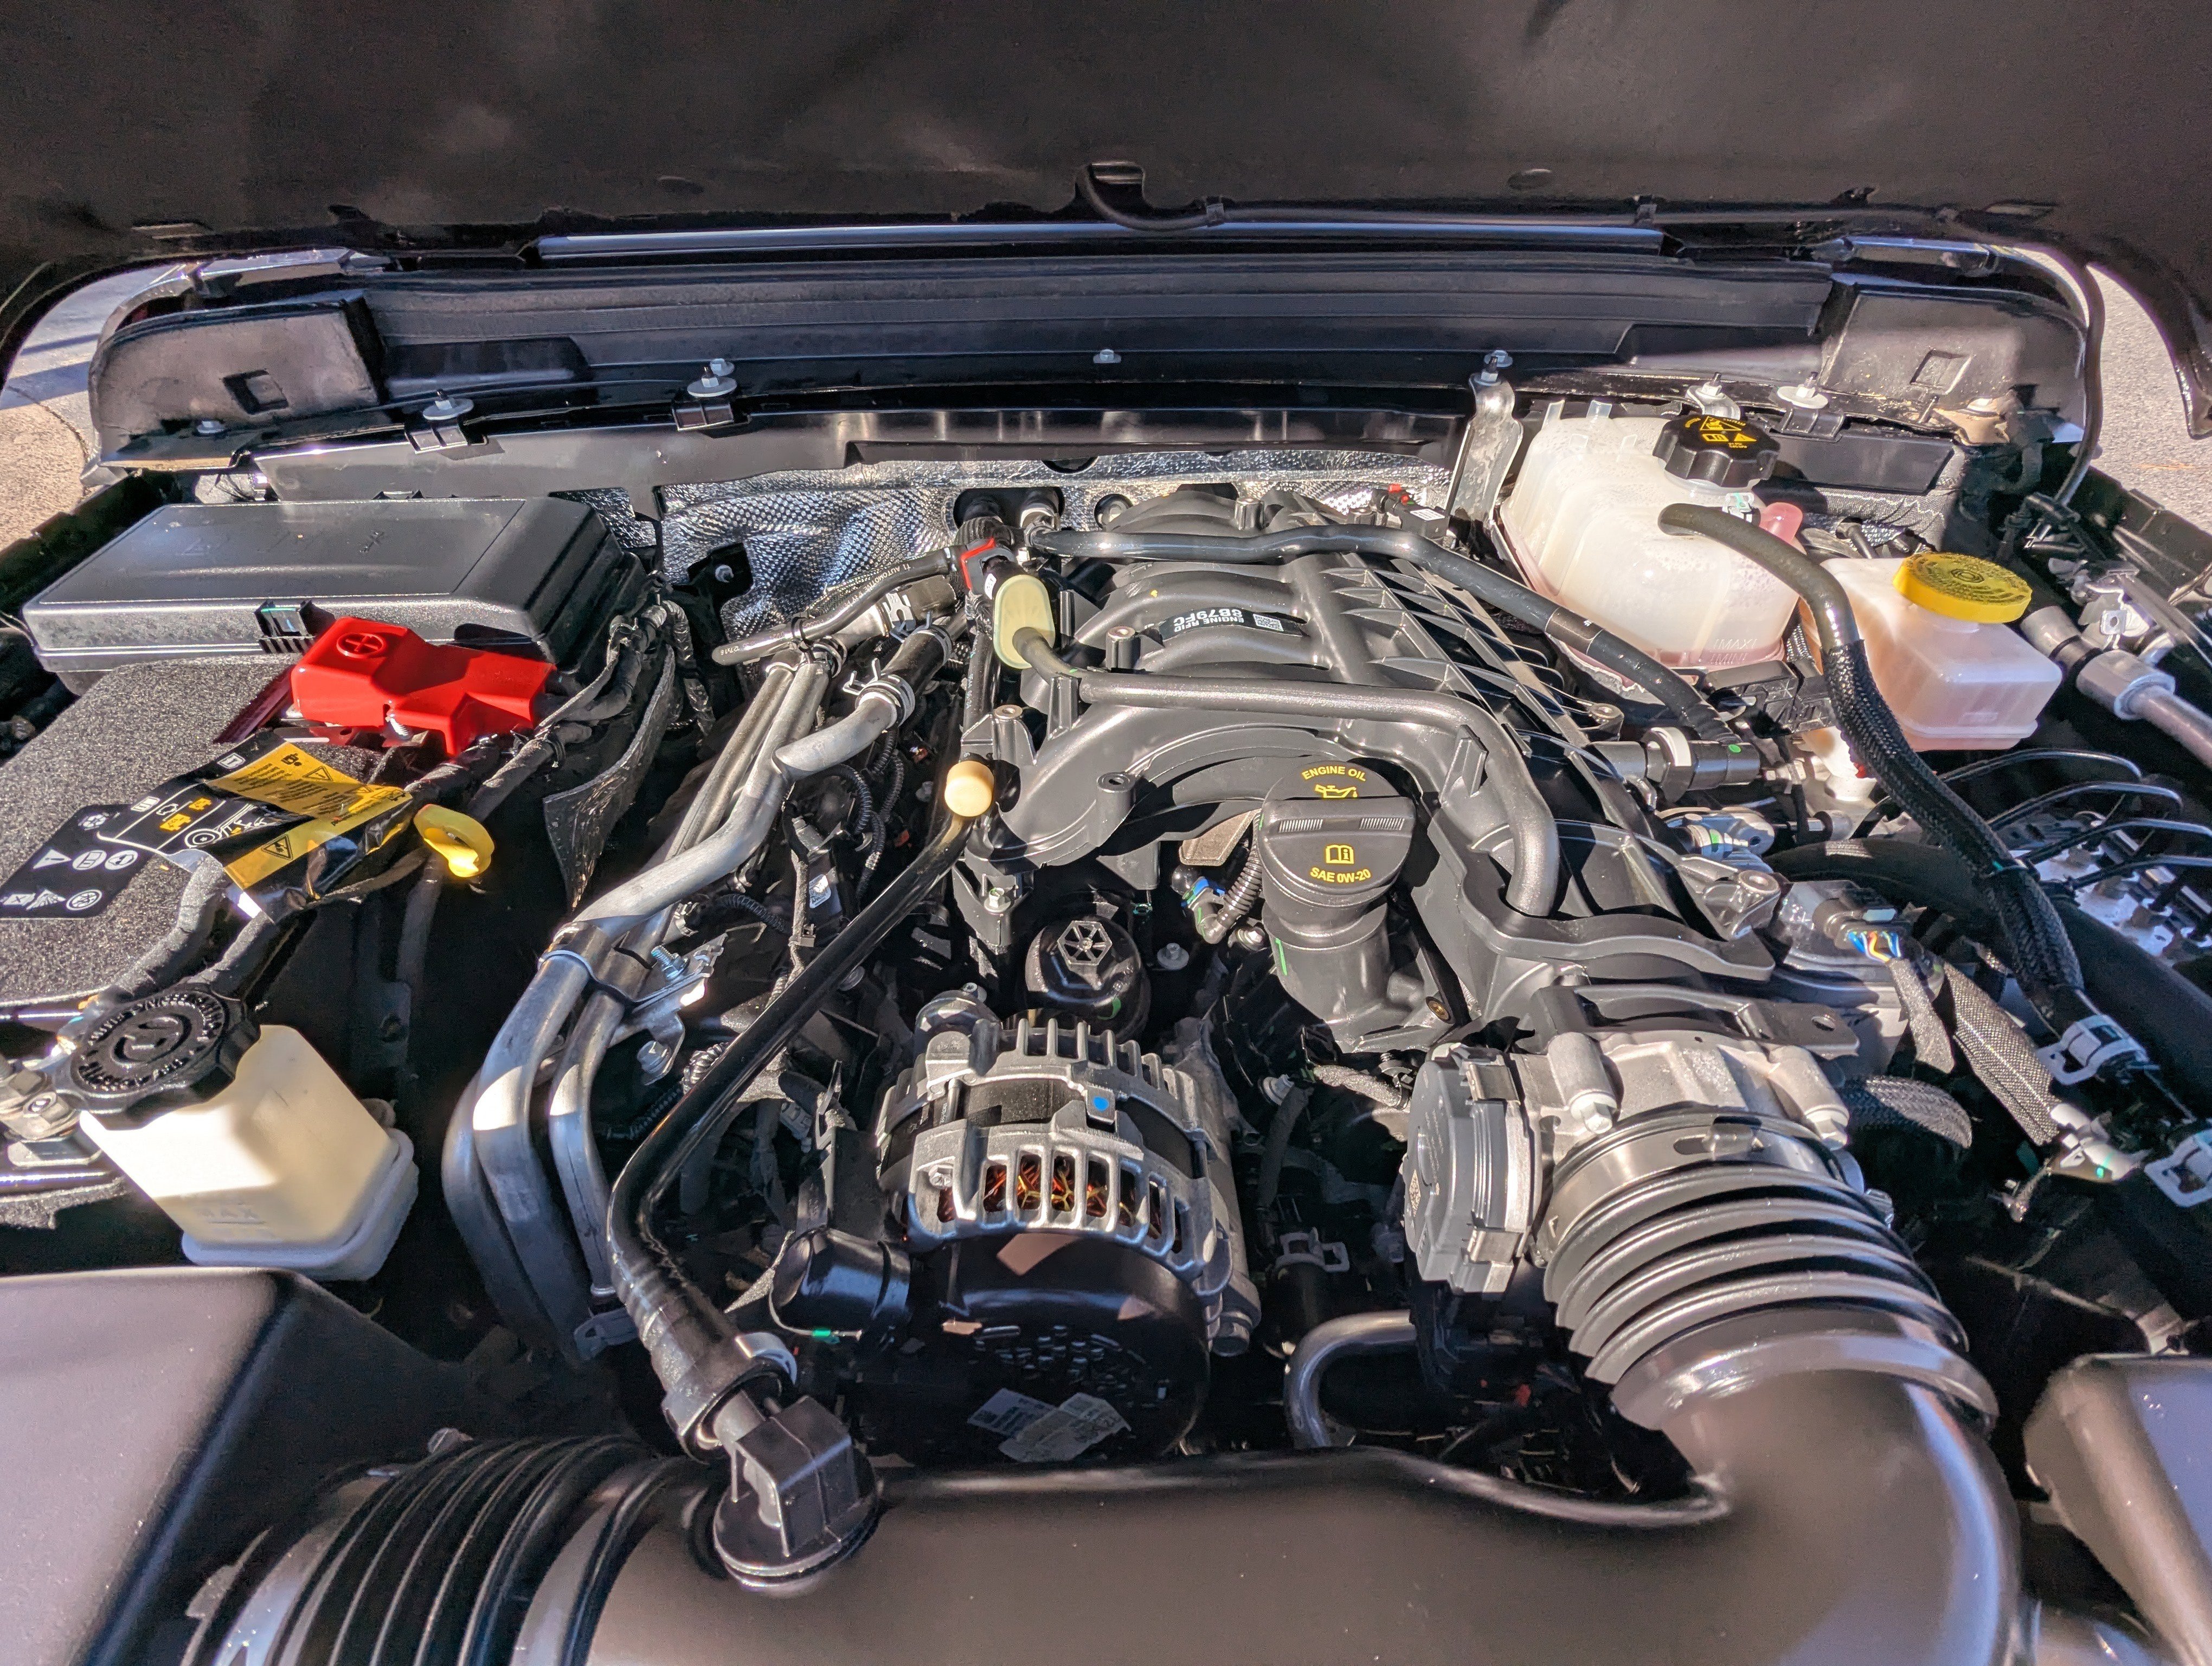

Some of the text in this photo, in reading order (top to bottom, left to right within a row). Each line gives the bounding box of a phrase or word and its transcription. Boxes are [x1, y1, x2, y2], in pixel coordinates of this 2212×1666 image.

[863, 566, 901, 591] AUTOMOTIVE
[1173, 608, 1243, 626] 8B79FC
[1174, 616, 1244, 632] ENGINE RFID
[1301, 766, 1367, 782] ENGINE OIL
[1310, 867, 1371, 883] SAE 0W-20
